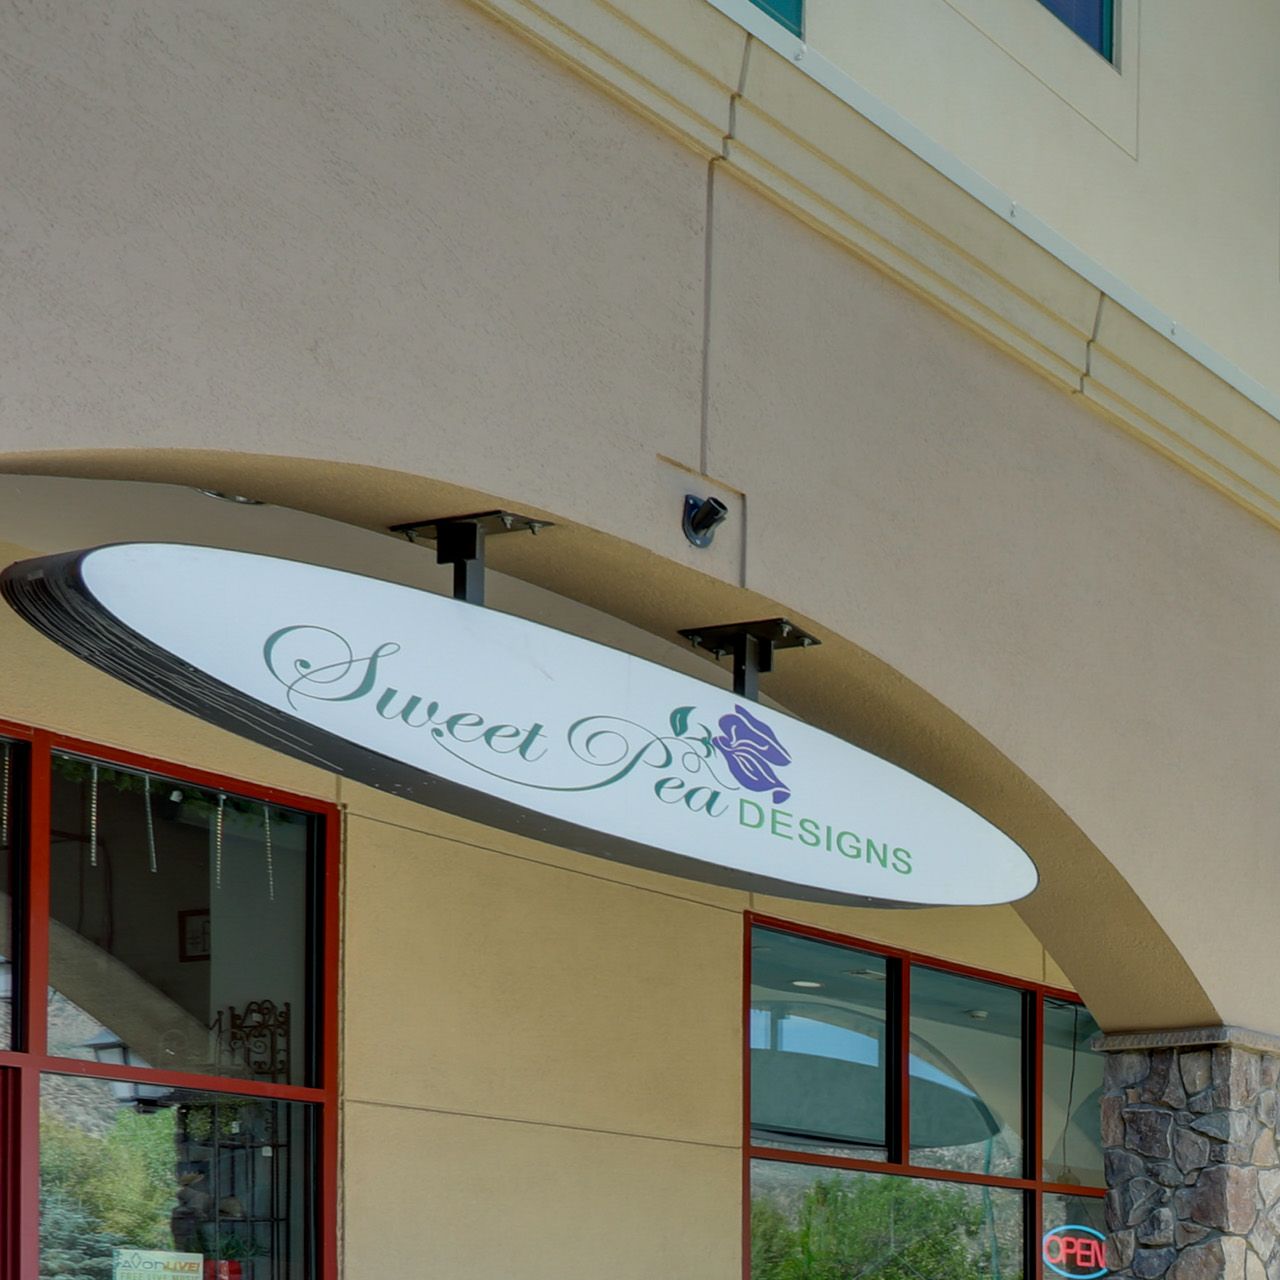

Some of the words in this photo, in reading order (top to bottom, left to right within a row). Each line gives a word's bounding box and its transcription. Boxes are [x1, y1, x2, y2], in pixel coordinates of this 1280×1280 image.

[262, 623, 551, 763] Sweet
[431, 714, 729, 819] Pea
[738, 796, 915, 877] DESIGNS
[1044, 1234, 1108, 1269] OPEN
